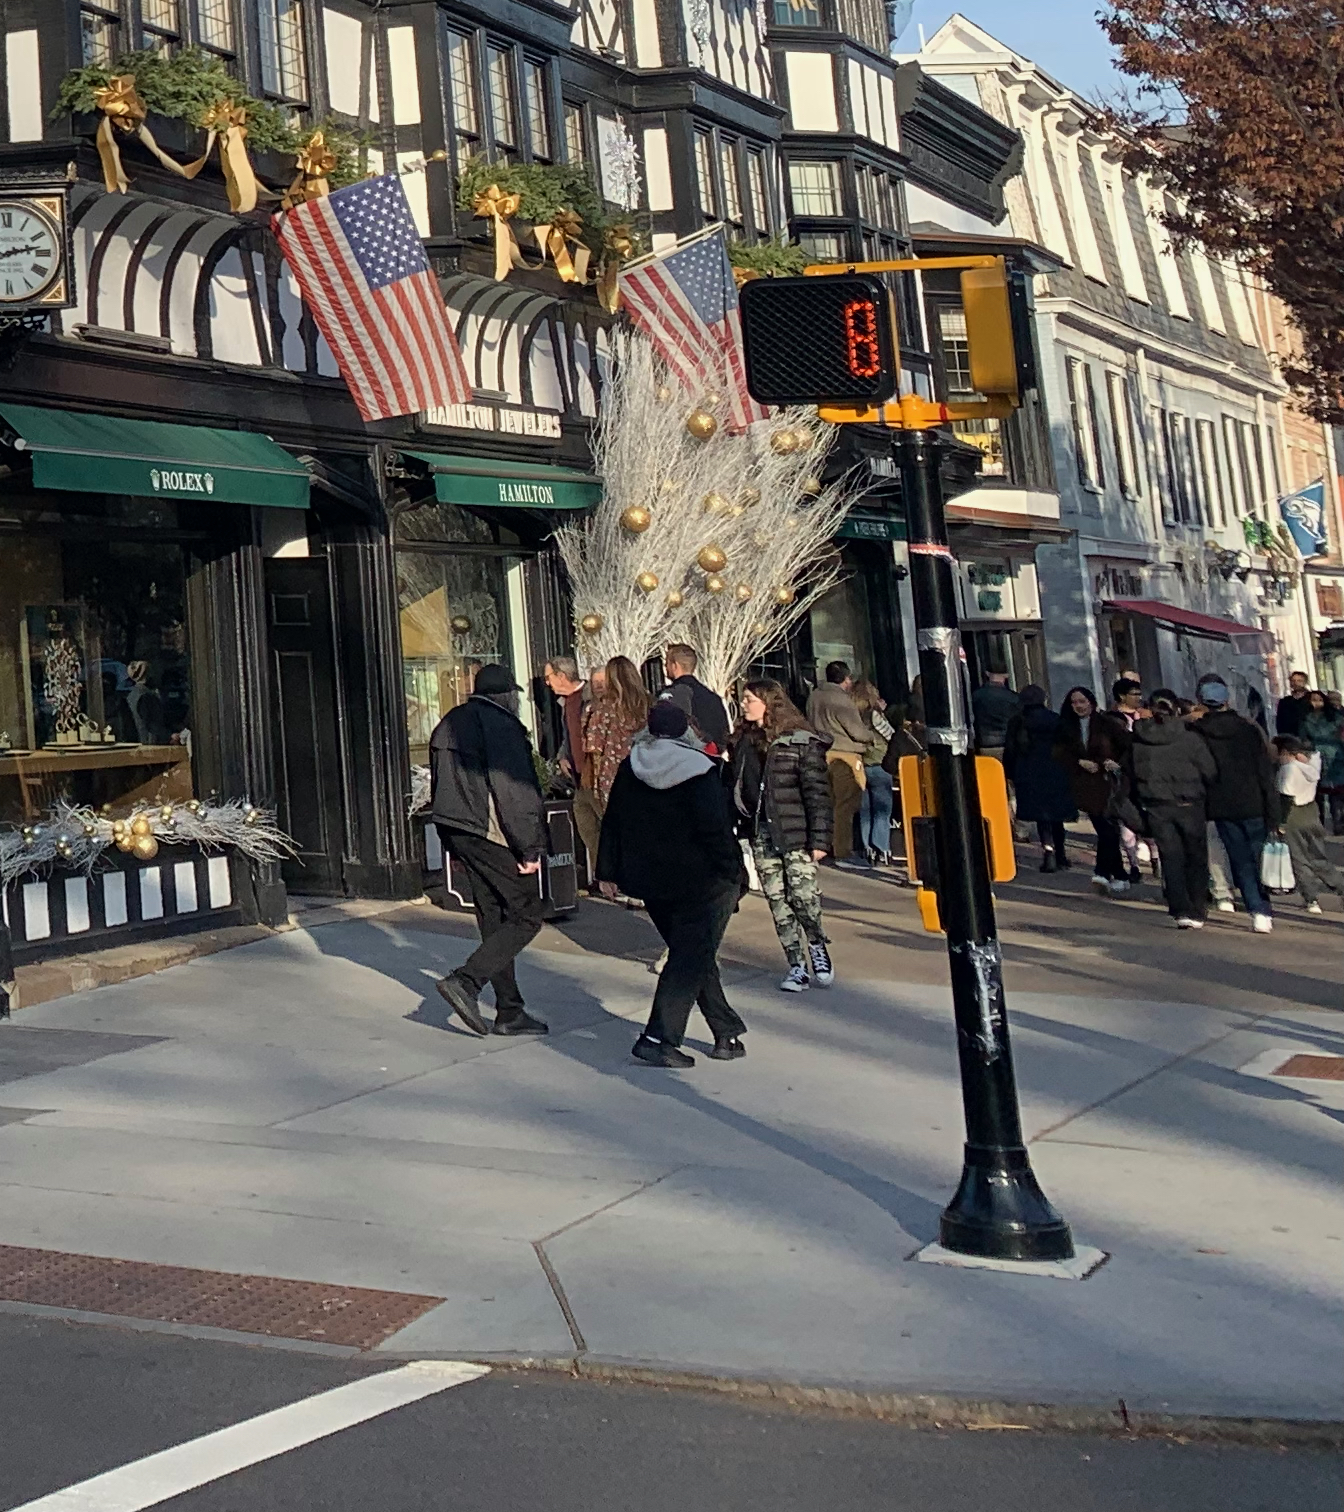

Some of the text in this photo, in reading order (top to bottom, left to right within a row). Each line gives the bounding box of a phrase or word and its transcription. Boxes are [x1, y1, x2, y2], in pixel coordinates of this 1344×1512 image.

[844, 300, 880, 377] 8
[426, 403, 561, 439] HAMILTON JEWELERS
[161, 470, 204, 493] ROLEX
[498, 483, 555, 504] HAMILTON
